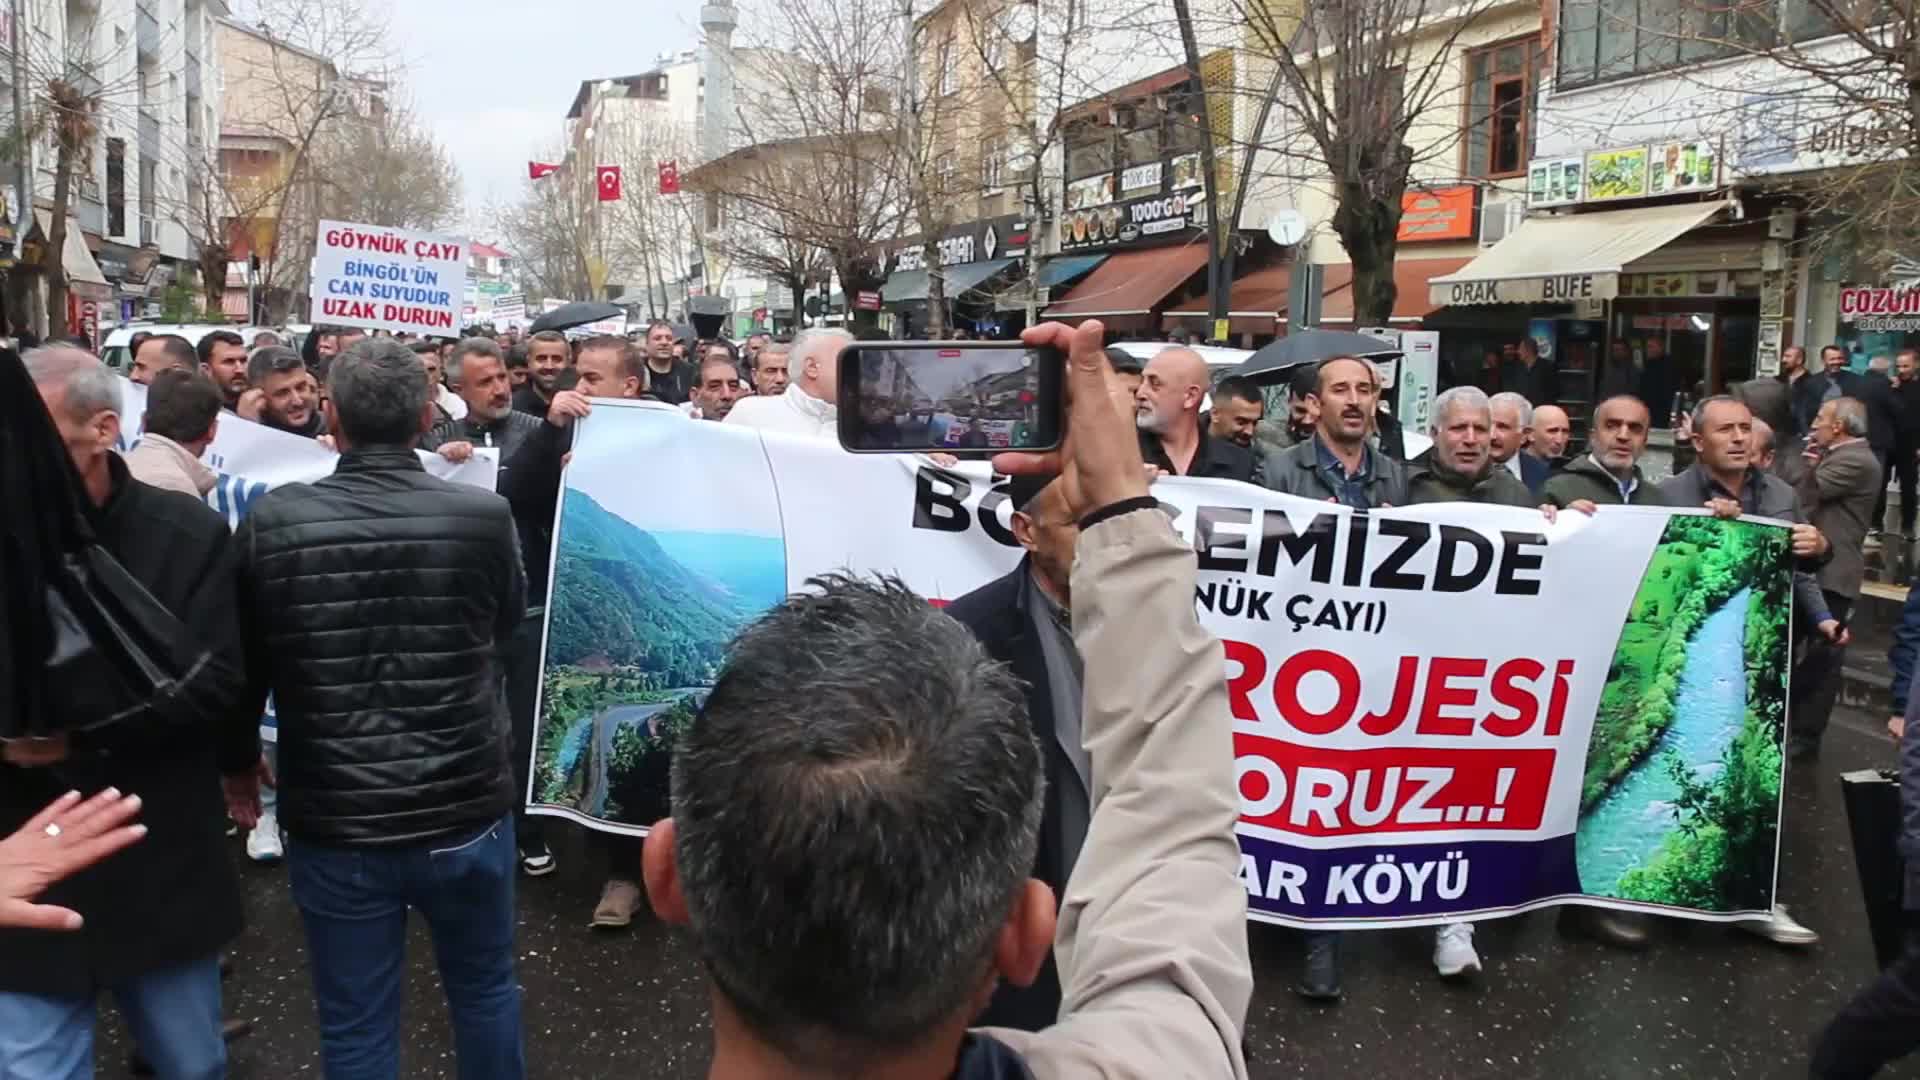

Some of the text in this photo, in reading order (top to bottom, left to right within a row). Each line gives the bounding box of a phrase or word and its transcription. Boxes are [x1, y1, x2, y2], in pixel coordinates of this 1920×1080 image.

[326, 228, 460, 262] GÖYNÜK ÇAYI
[344, 259, 438, 286] BİNGÖL'ÜN
[328, 279, 364, 296] CAN
[370, 283, 450, 306] SUYUDUR
[1451, 280, 1498, 302] ORAK
[323, 298, 453, 328] UZAK DURUN
[912, 466, 1548, 595] BÖEMİZDE
[1285, 593, 1387, 635] ÇAYI)
[1222, 639, 1576, 737] ROJESİ
[1236, 850, 1469, 905] AR KÖYÜ
